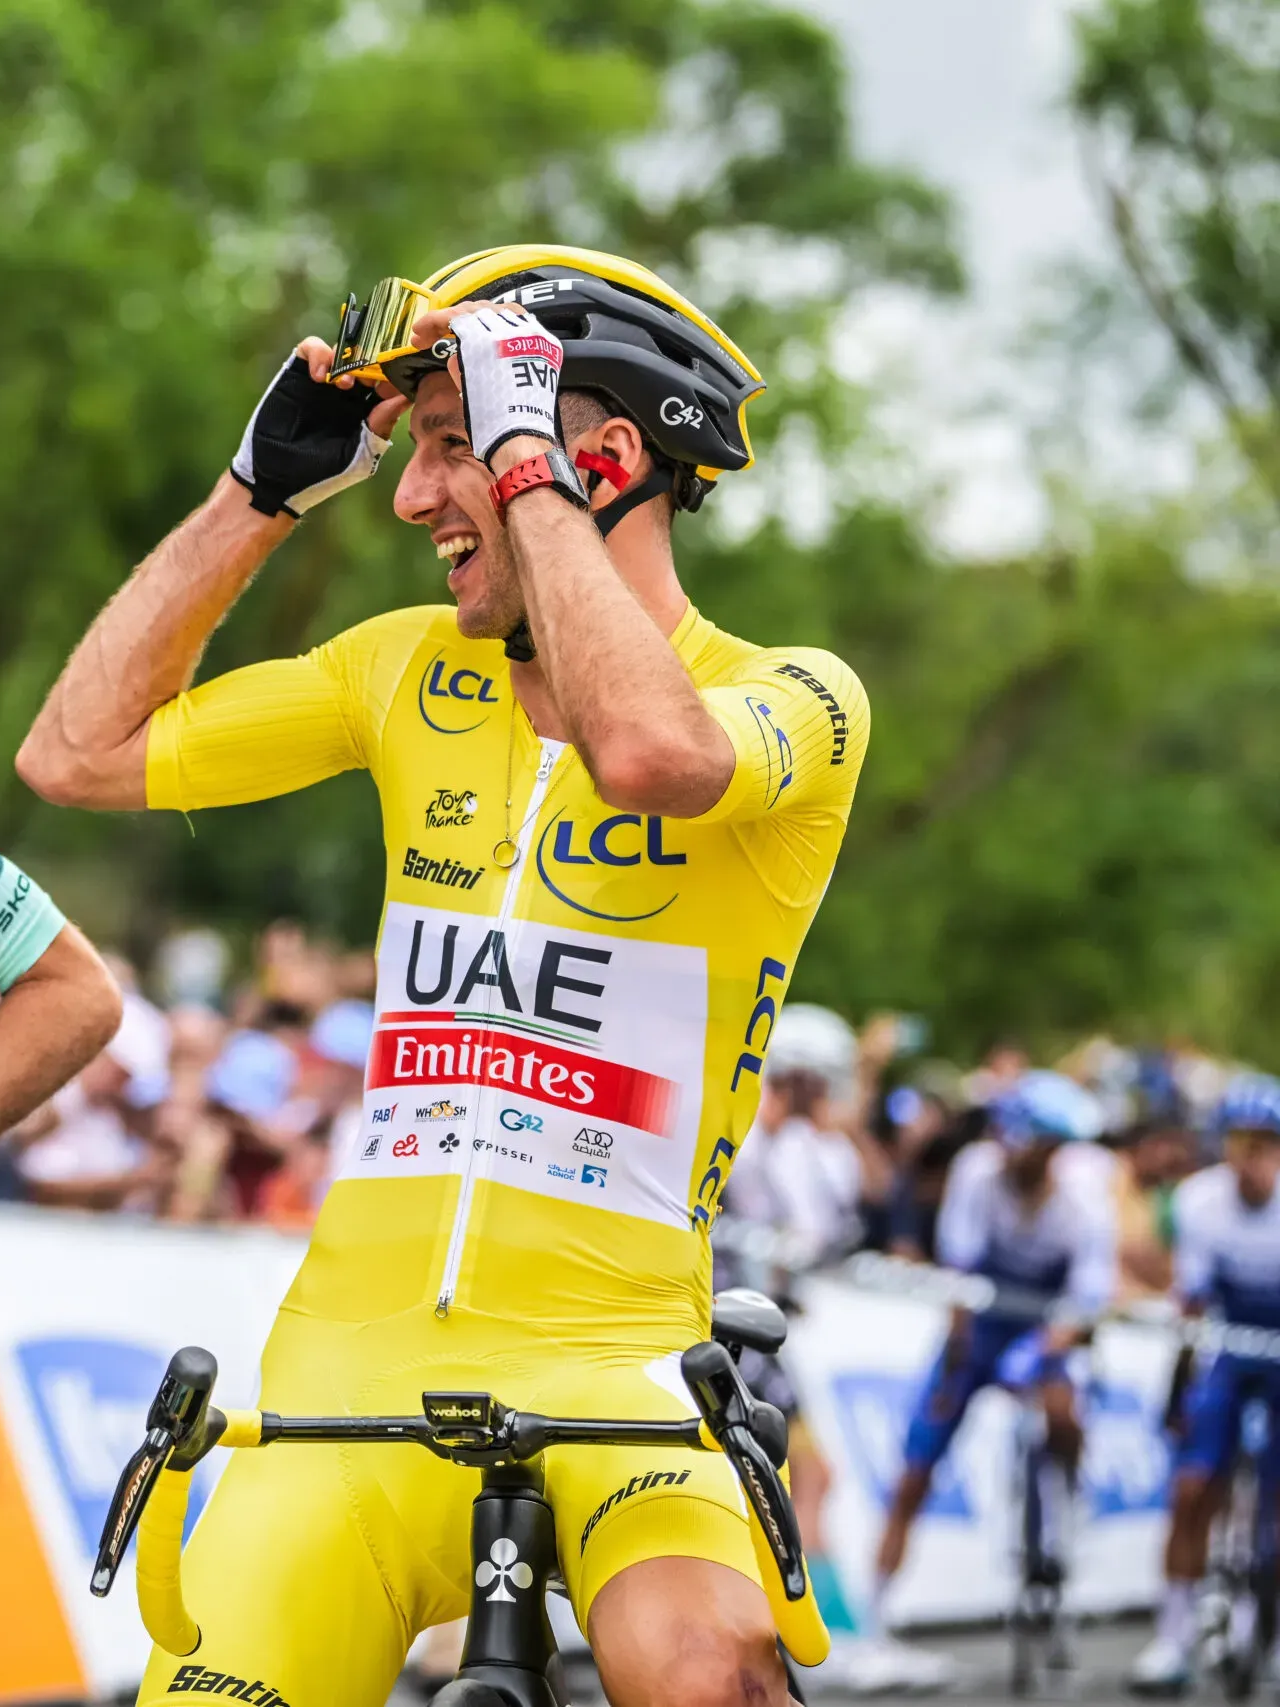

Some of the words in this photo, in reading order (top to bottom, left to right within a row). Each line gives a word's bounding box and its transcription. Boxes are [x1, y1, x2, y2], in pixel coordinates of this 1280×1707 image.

[432, 339, 458, 359] G4
[506, 335, 560, 362] Emirates
[508, 404, 544, 416] MILLE
[660, 396, 704, 430] G42
[428, 659, 499, 703] LCL
[773, 663, 849, 766] Santini
[552, 813, 688, 866] LCL
[401, 847, 486, 890] Santini
[405, 919, 613, 1033] UAE
[730, 956, 787, 1093] LCL
[393, 1035, 596, 1105] Emirates
[499, 1108, 544, 1134] G42
[485, 1142, 534, 1164] PISSEI
[573, 1127, 614, 1151] ADQ
[546, 1169, 576, 1181] ADNOC
[430, 1405, 482, 1418] wahoo
[580, 1469, 692, 1559] Santini
